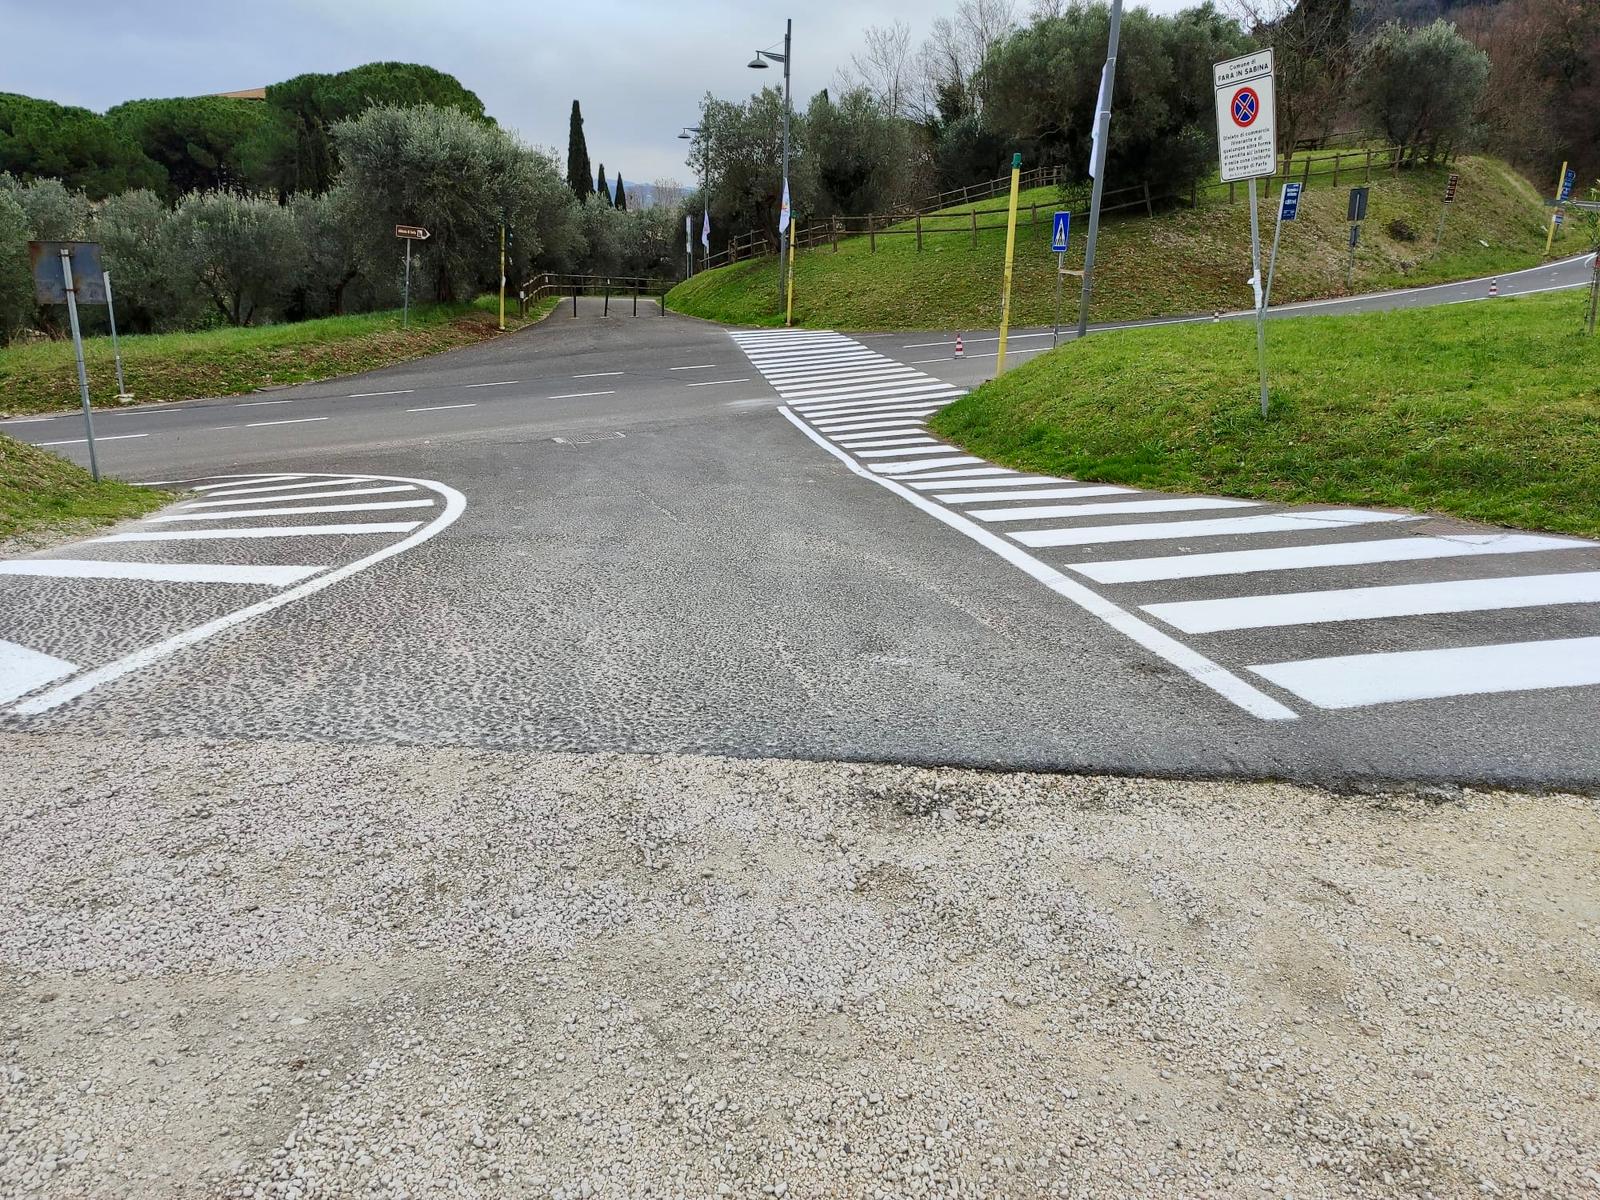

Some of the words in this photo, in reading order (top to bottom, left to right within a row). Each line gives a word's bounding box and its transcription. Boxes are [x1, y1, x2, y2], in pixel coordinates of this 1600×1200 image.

[1229, 61, 1250, 70] Comune
[1217, 72, 1235, 82] FARA
[1236, 69, 1243, 77] IN
[1244, 63, 1269, 75] SABINA
[1245, 128, 1270, 136] commercio
